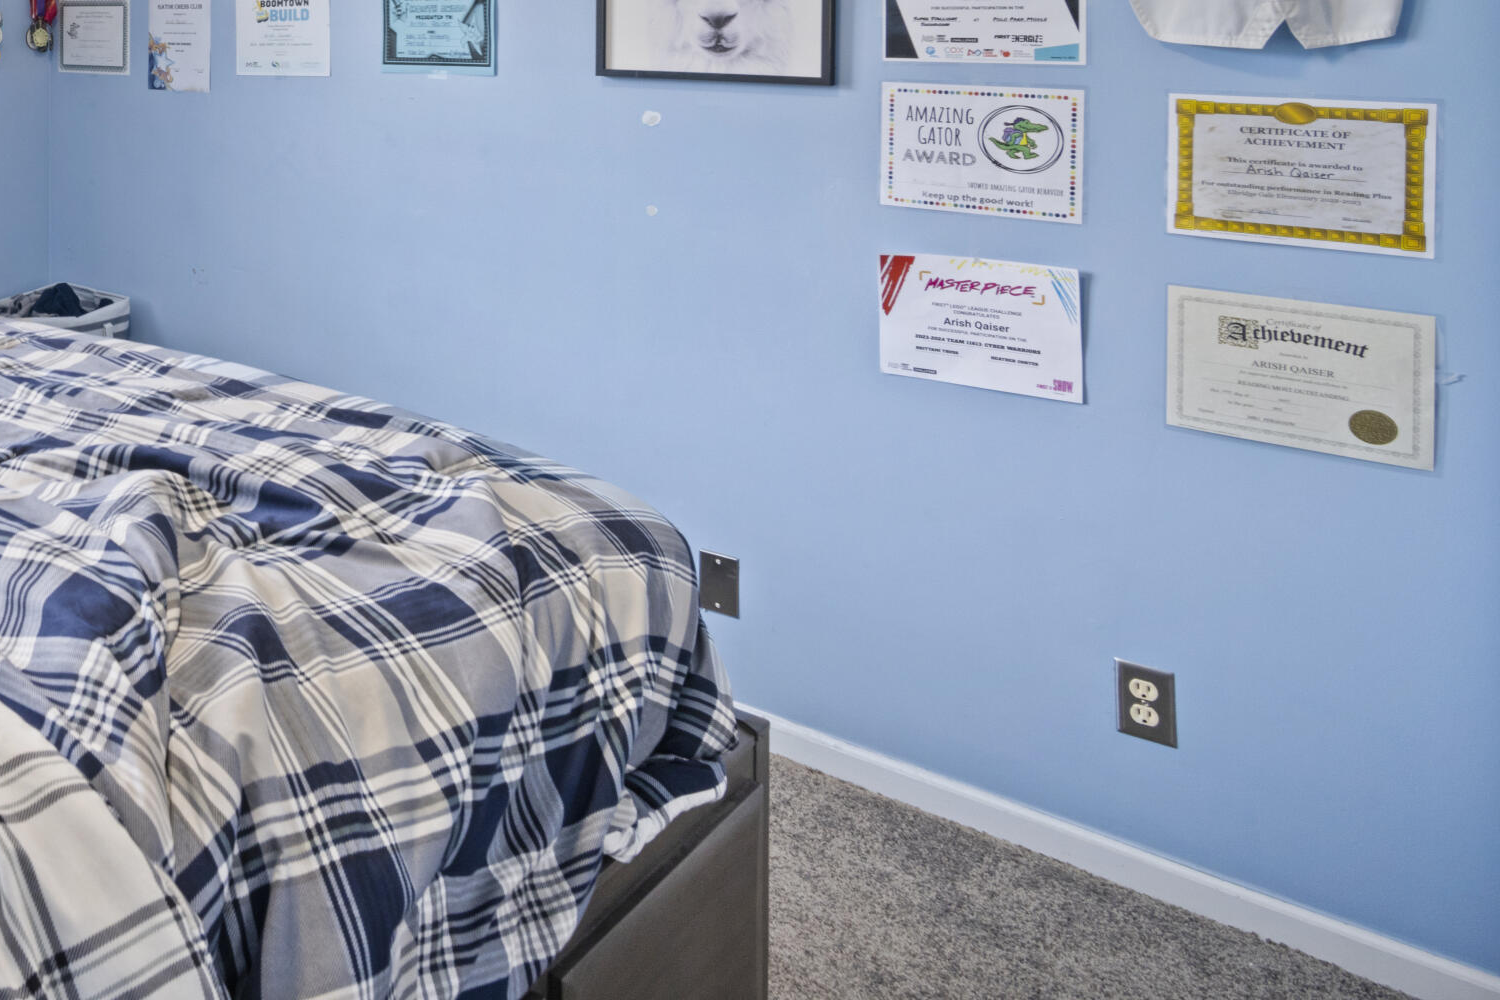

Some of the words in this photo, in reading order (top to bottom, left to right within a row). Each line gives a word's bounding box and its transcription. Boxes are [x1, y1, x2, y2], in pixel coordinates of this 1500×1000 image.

[269, 7, 310, 22] BUILD
[906, 105, 974, 125] AMAZING
[917, 126, 962, 146] GATOR
[1239, 126, 1329, 140] CERTIFICATE
[1331, 130, 1351, 140] OF
[1243, 138, 1346, 151] ACHIEVEMENT
[902, 149, 977, 167] AWARD
[1227, 156, 1247, 164] This
[1249, 158, 1296, 167] certificate
[1308, 163, 1350, 171] awarded
[1245, 165, 1284, 177] Arish
[1290, 167, 1335, 180] Qaiser
[1216, 181, 1264, 191] outstanding
[1334, 190, 1370, 199] Reading
[922, 191, 945, 202] Keep
[947, 193, 960, 204] up
[962, 193, 977, 202] the
[979, 197, 1004, 205] good
[1006, 199, 1034, 208] work!
[943, 317, 972, 329] Arish
[974, 321, 1010, 333] Qaiser
[1266, 317, 1309, 332] Certificate
[1312, 324, 1322, 332] of
[1227, 322, 1369, 359] Achievement
[1252, 360, 1287, 371] ARISH
[1289, 365, 1335, 378] QAISER
